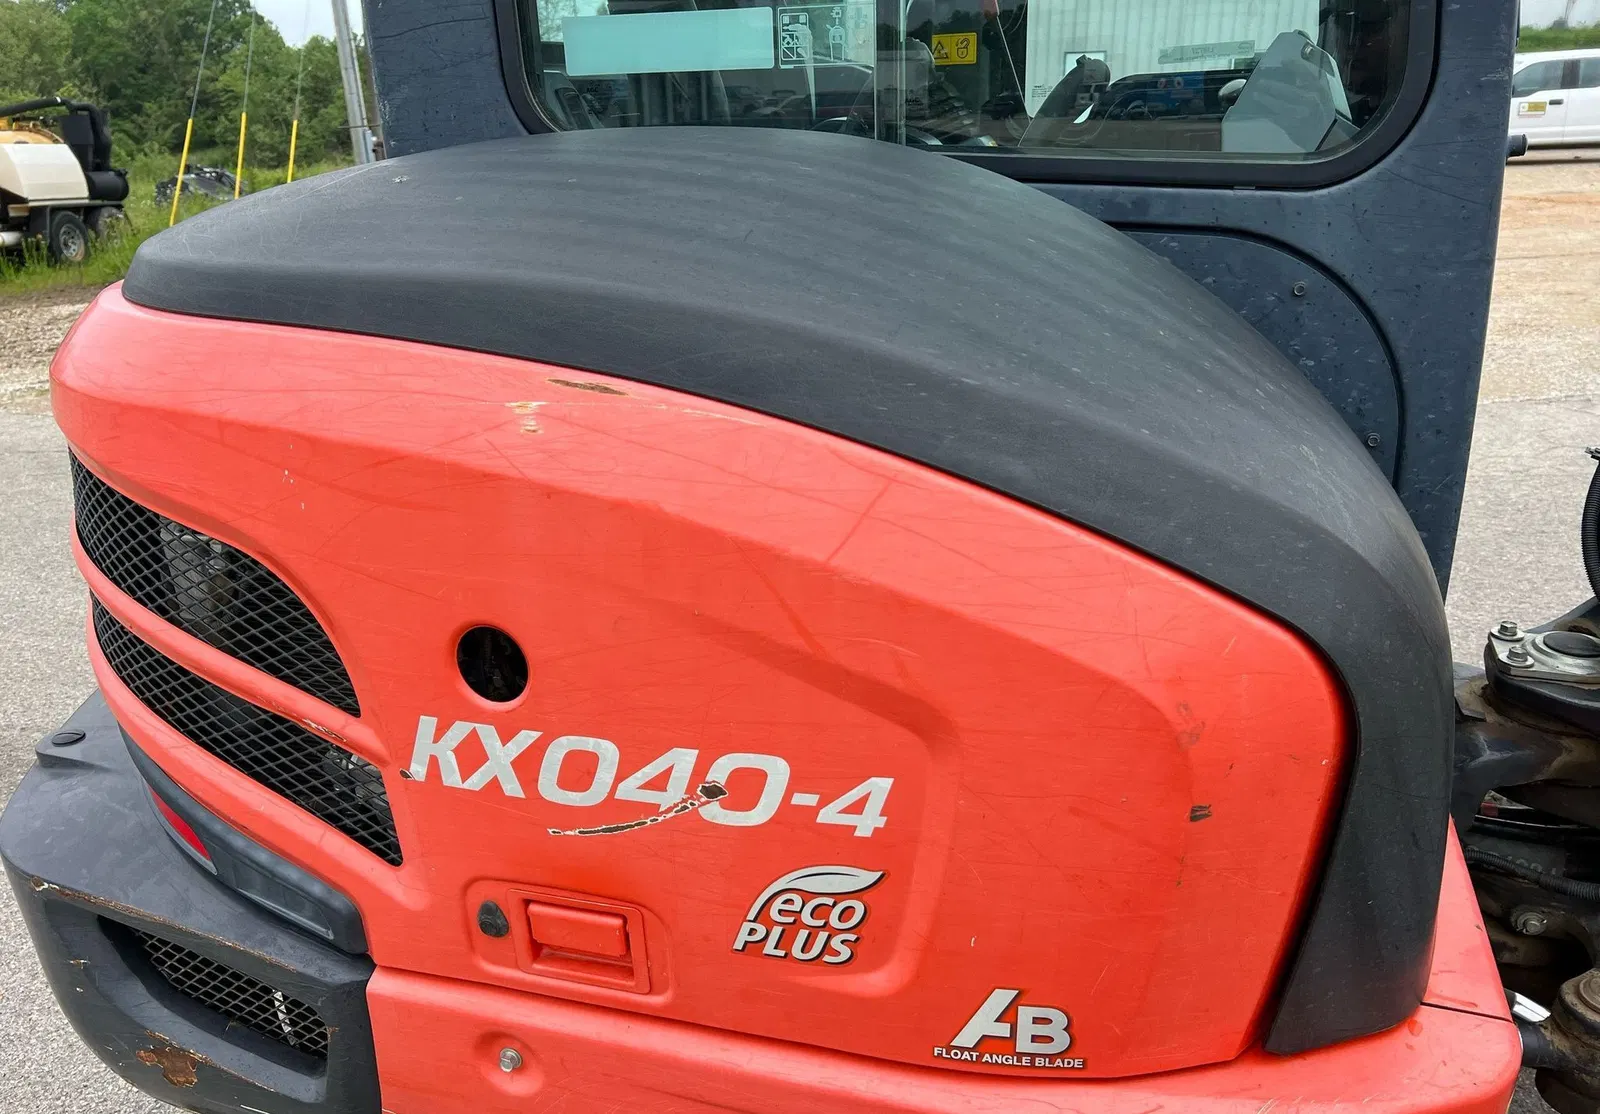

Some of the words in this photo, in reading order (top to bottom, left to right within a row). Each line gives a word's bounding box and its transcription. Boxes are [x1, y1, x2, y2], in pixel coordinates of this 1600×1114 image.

[407, 715, 895, 837] KX040-4
[769, 892, 867, 930] eco
[732, 921, 861, 964] PLUS
[949, 988, 1072, 1055] AB
[933, 1047, 979, 1062] FLOAT
[981, 1053, 1031, 1066] ANGLE
[1034, 1057, 1084, 1068] BLADE
